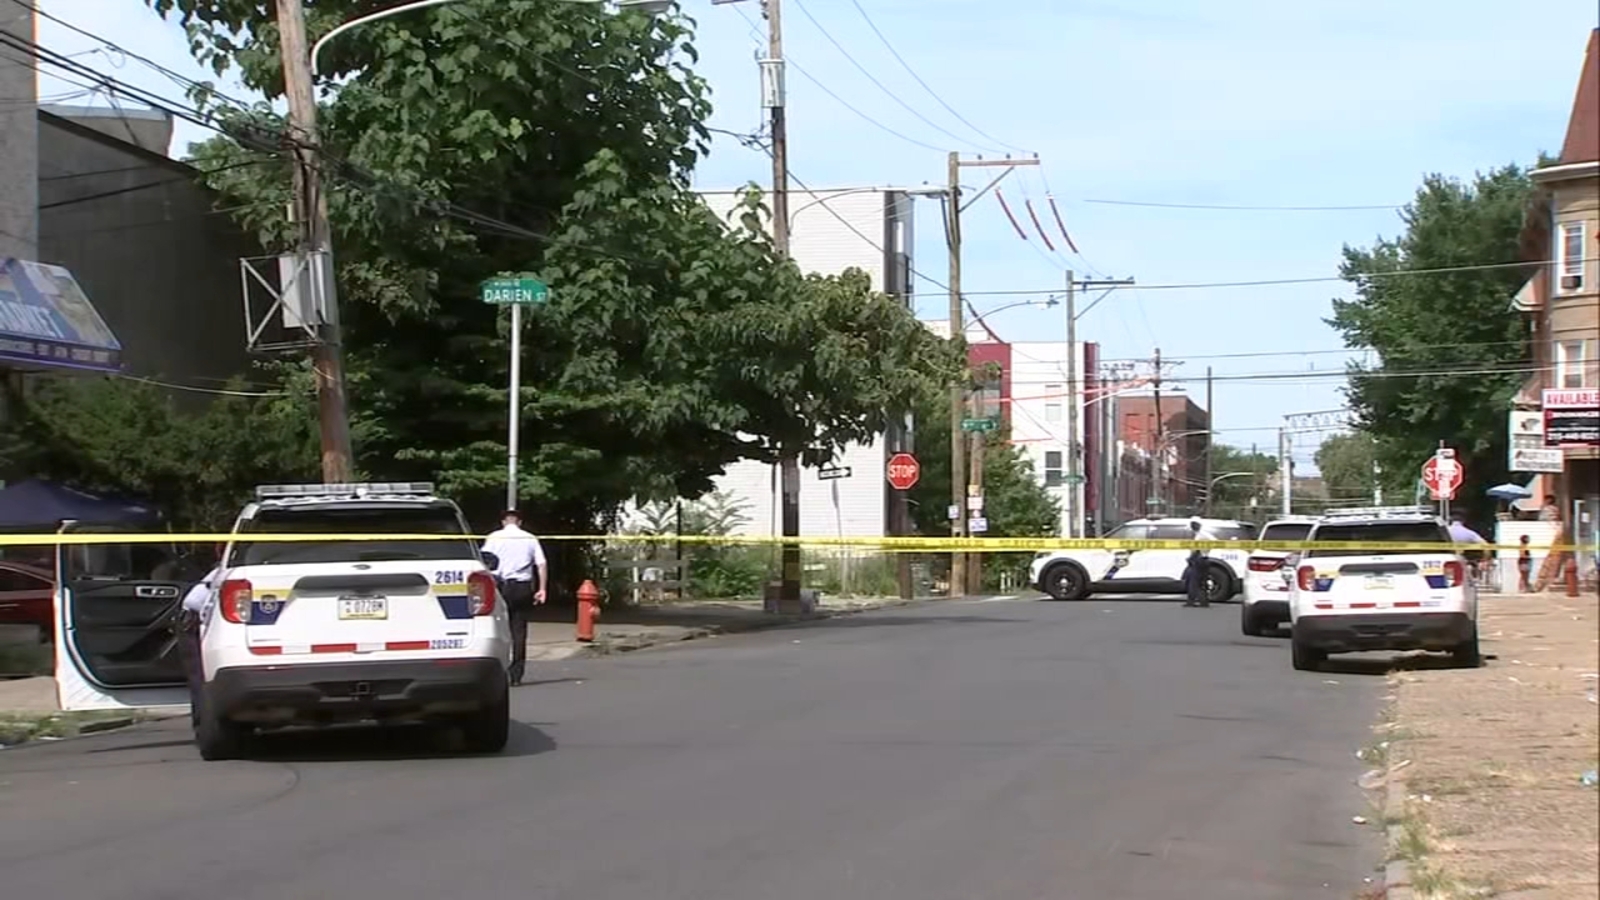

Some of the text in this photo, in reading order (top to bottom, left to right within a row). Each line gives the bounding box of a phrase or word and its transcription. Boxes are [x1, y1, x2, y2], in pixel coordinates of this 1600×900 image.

[483, 289, 532, 302] DARIEN
[1546, 392, 1600, 405] AVAILABLE
[889, 464, 916, 478] STOP
[435, 570, 464, 584] 2614
